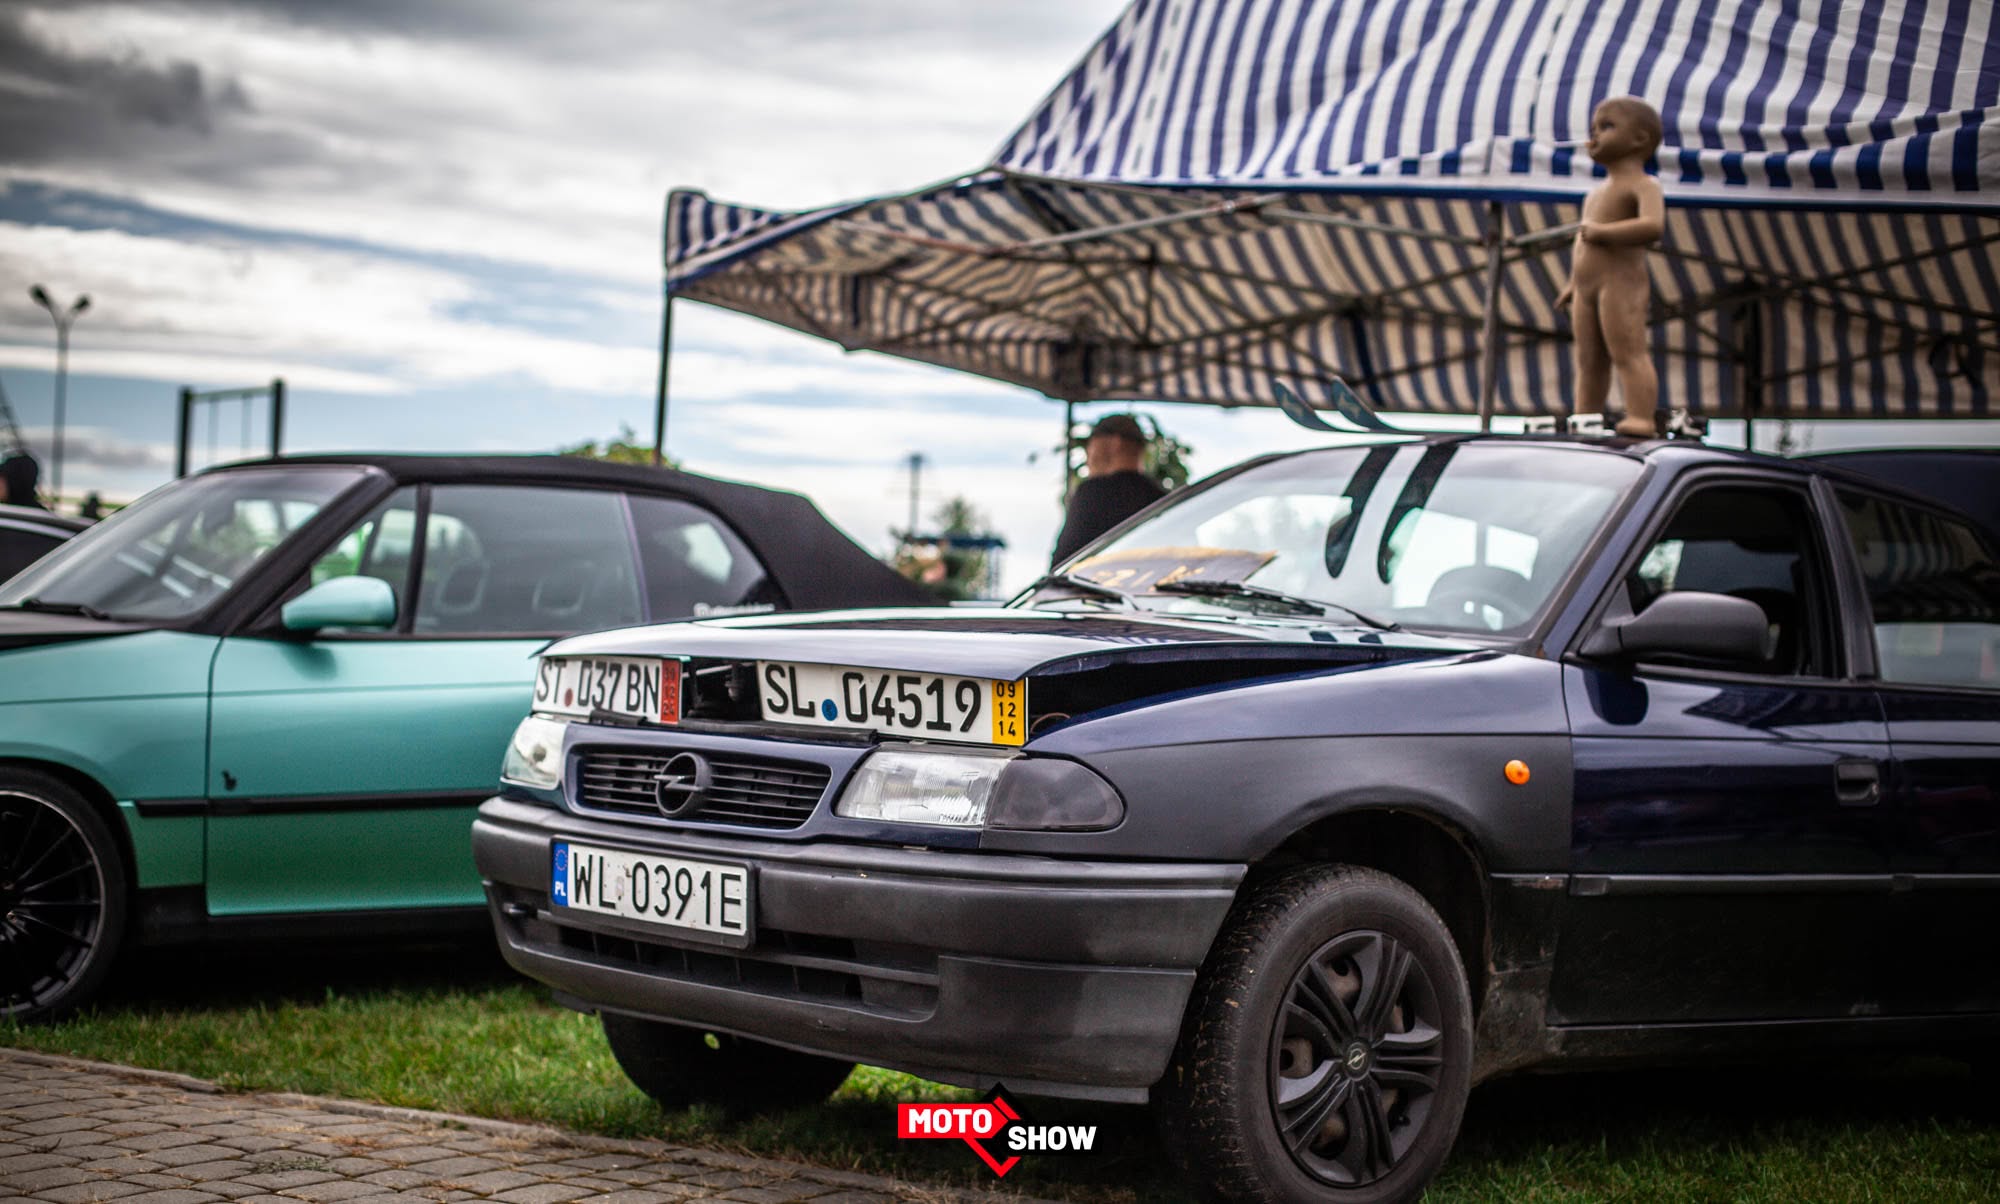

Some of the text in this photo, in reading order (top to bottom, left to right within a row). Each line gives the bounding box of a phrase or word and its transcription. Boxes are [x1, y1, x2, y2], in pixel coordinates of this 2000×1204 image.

[537, 657, 567, 704] ST
[996, 681, 1016, 698] 09
[765, 664, 981, 733] SL 04519
[998, 701, 1016, 718] 12
[998, 720, 1016, 737] 14
[555, 881, 566, 897] PL
[573, 852, 741, 929] WL 0391E
